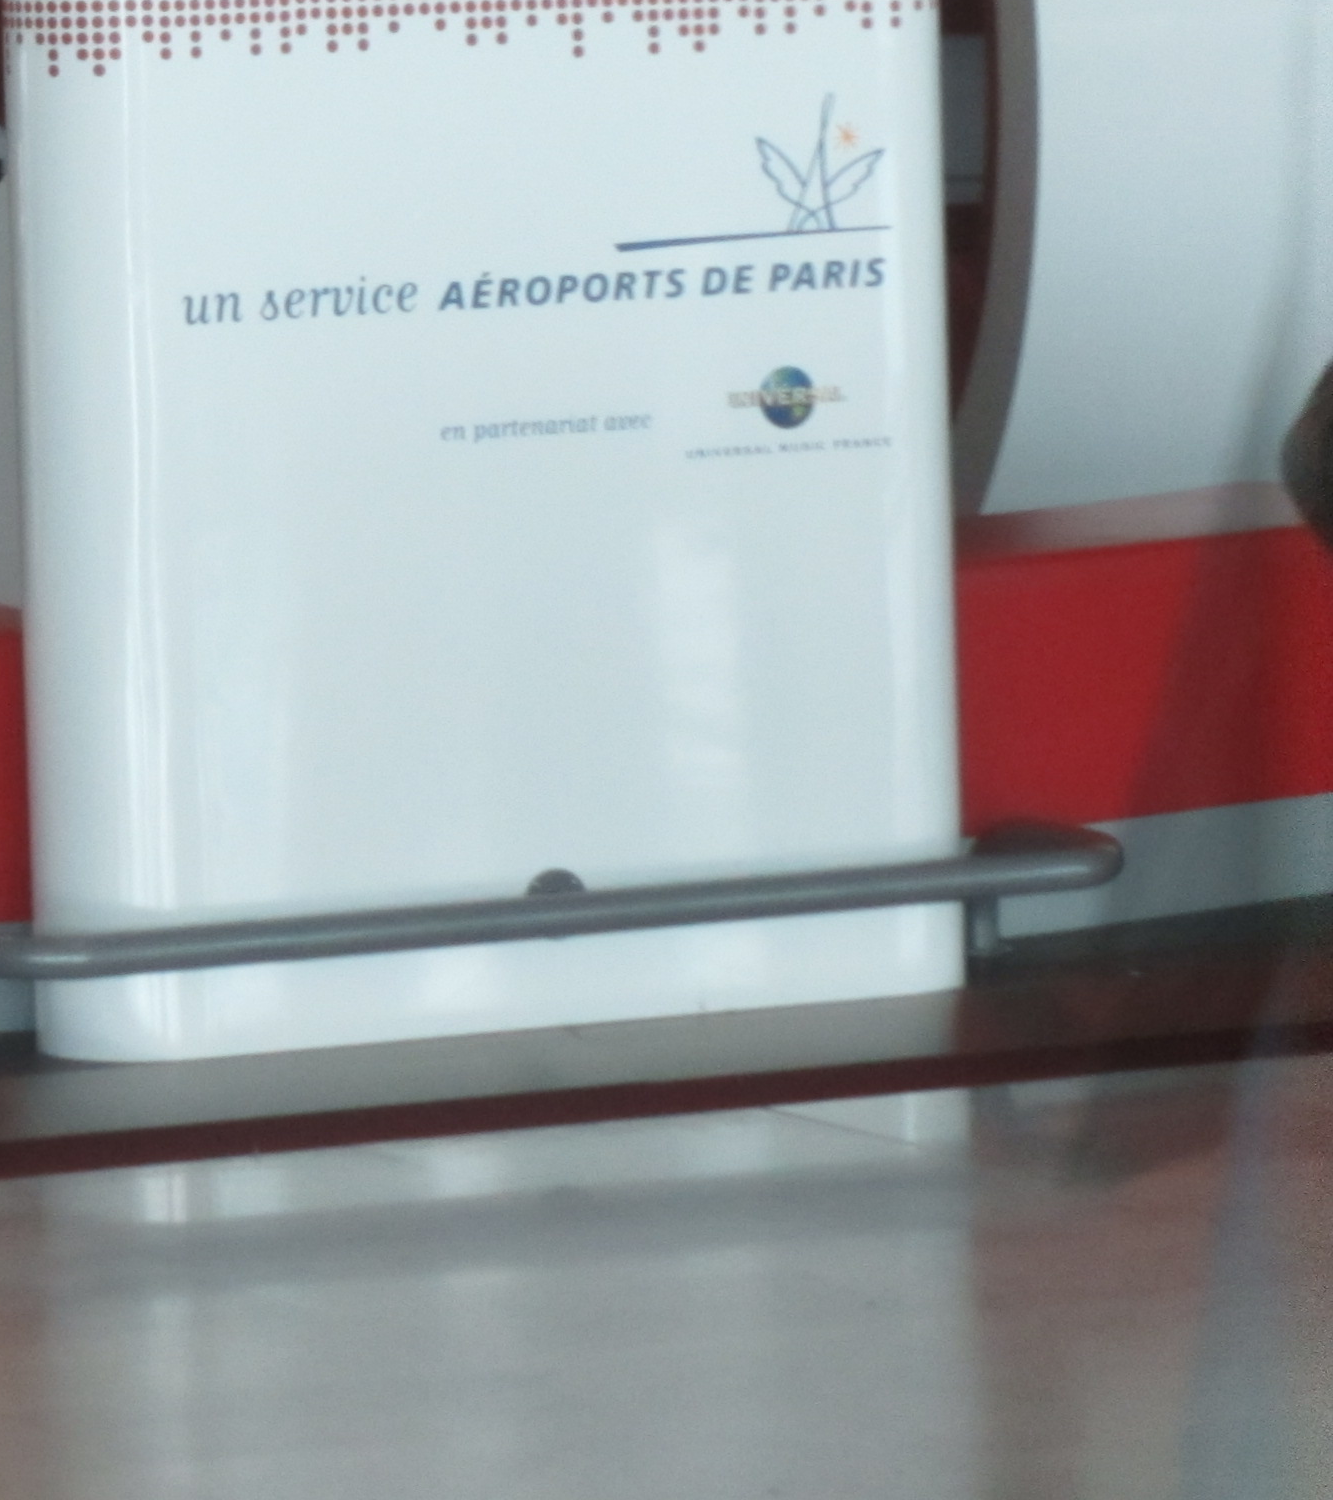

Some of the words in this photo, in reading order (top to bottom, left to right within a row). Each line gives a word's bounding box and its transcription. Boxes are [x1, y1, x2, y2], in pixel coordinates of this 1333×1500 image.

[183, 290, 243, 325] un
[259, 275, 418, 321] service
[438, 266, 686, 311] AÉROPORTS
[701, 264, 755, 296] DE
[768, 257, 885, 292] PARIS
[440, 425, 466, 441] en
[474, 415, 597, 443] partenariat
[604, 415, 652, 431] avec
